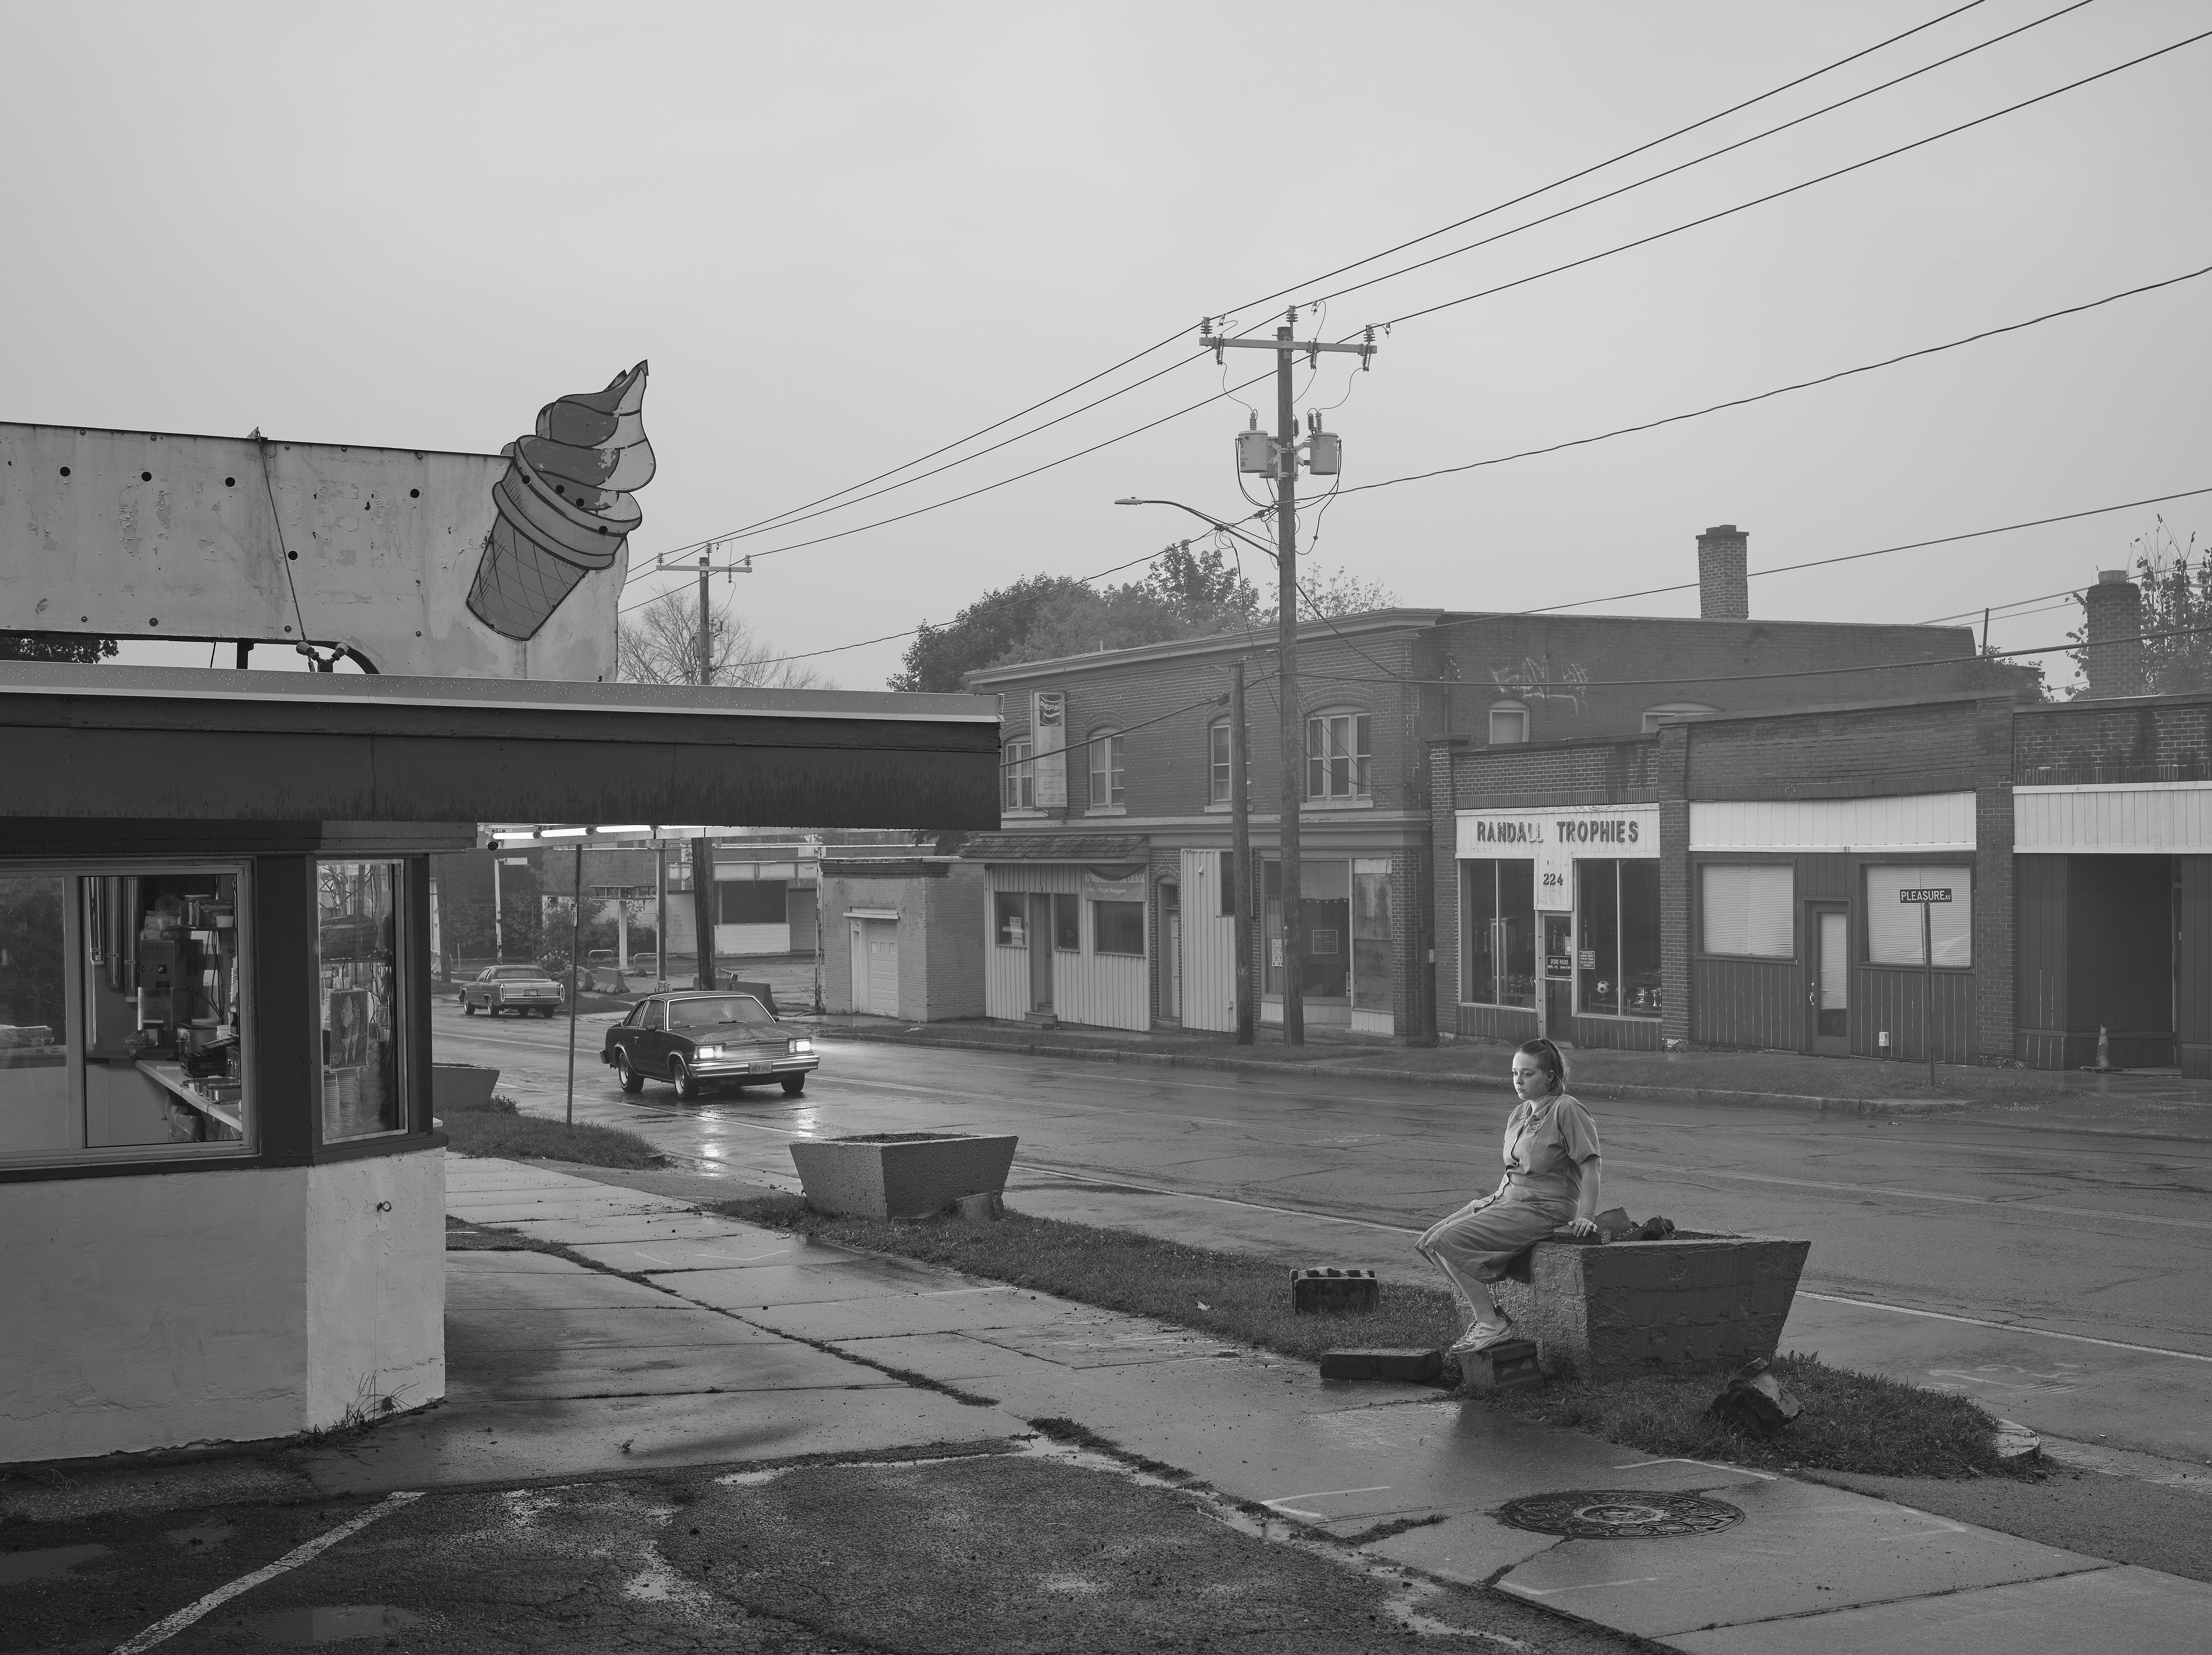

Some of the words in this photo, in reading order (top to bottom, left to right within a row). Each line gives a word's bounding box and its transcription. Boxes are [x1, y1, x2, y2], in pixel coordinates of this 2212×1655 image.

[1040, 700, 1061, 711] PEPSI
[1477, 821, 1544, 842] RANDALL
[1557, 820, 1638, 843] TROPHIES
[1085, 873, 1115, 883] STOREFR
[1128, 874, 1145, 883] LEASE
[1543, 873, 1563, 886] 224
[1901, 890, 1945, 901] PLEASURE
[158, 901, 179, 911] LED
